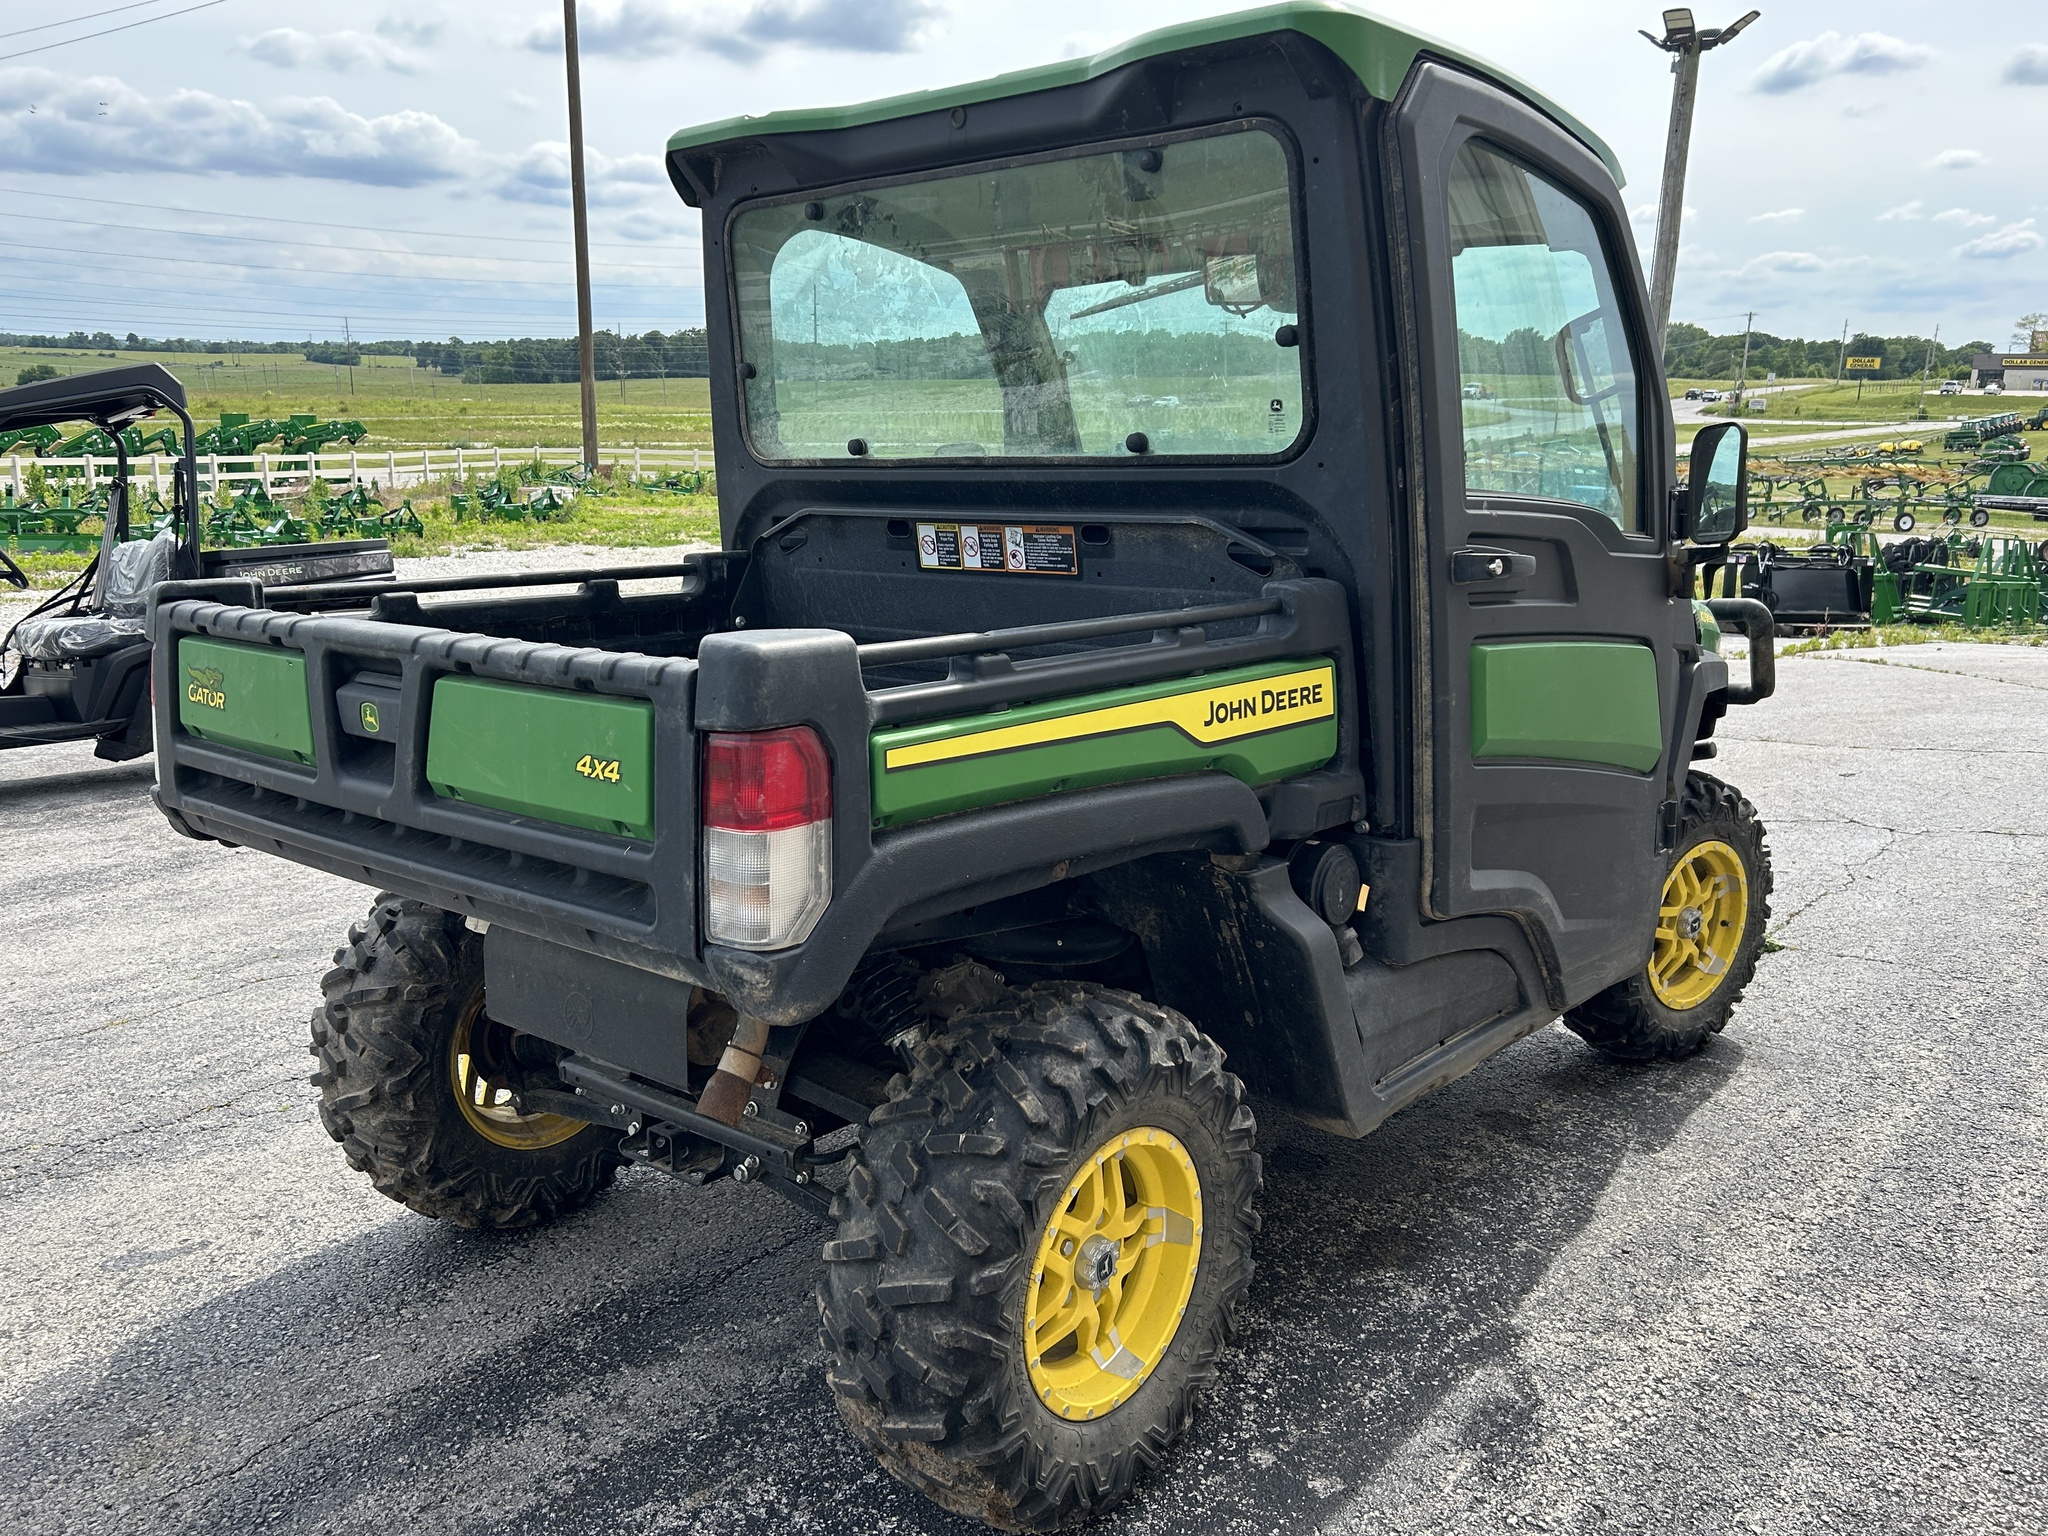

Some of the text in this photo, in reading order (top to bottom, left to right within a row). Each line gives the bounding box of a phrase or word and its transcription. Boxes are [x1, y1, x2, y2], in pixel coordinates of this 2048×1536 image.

[240, 566, 303, 578] JOHN DEERE
[188, 683, 226, 710] GATOR
[1203, 683, 1323, 727] JOHN DEERE
